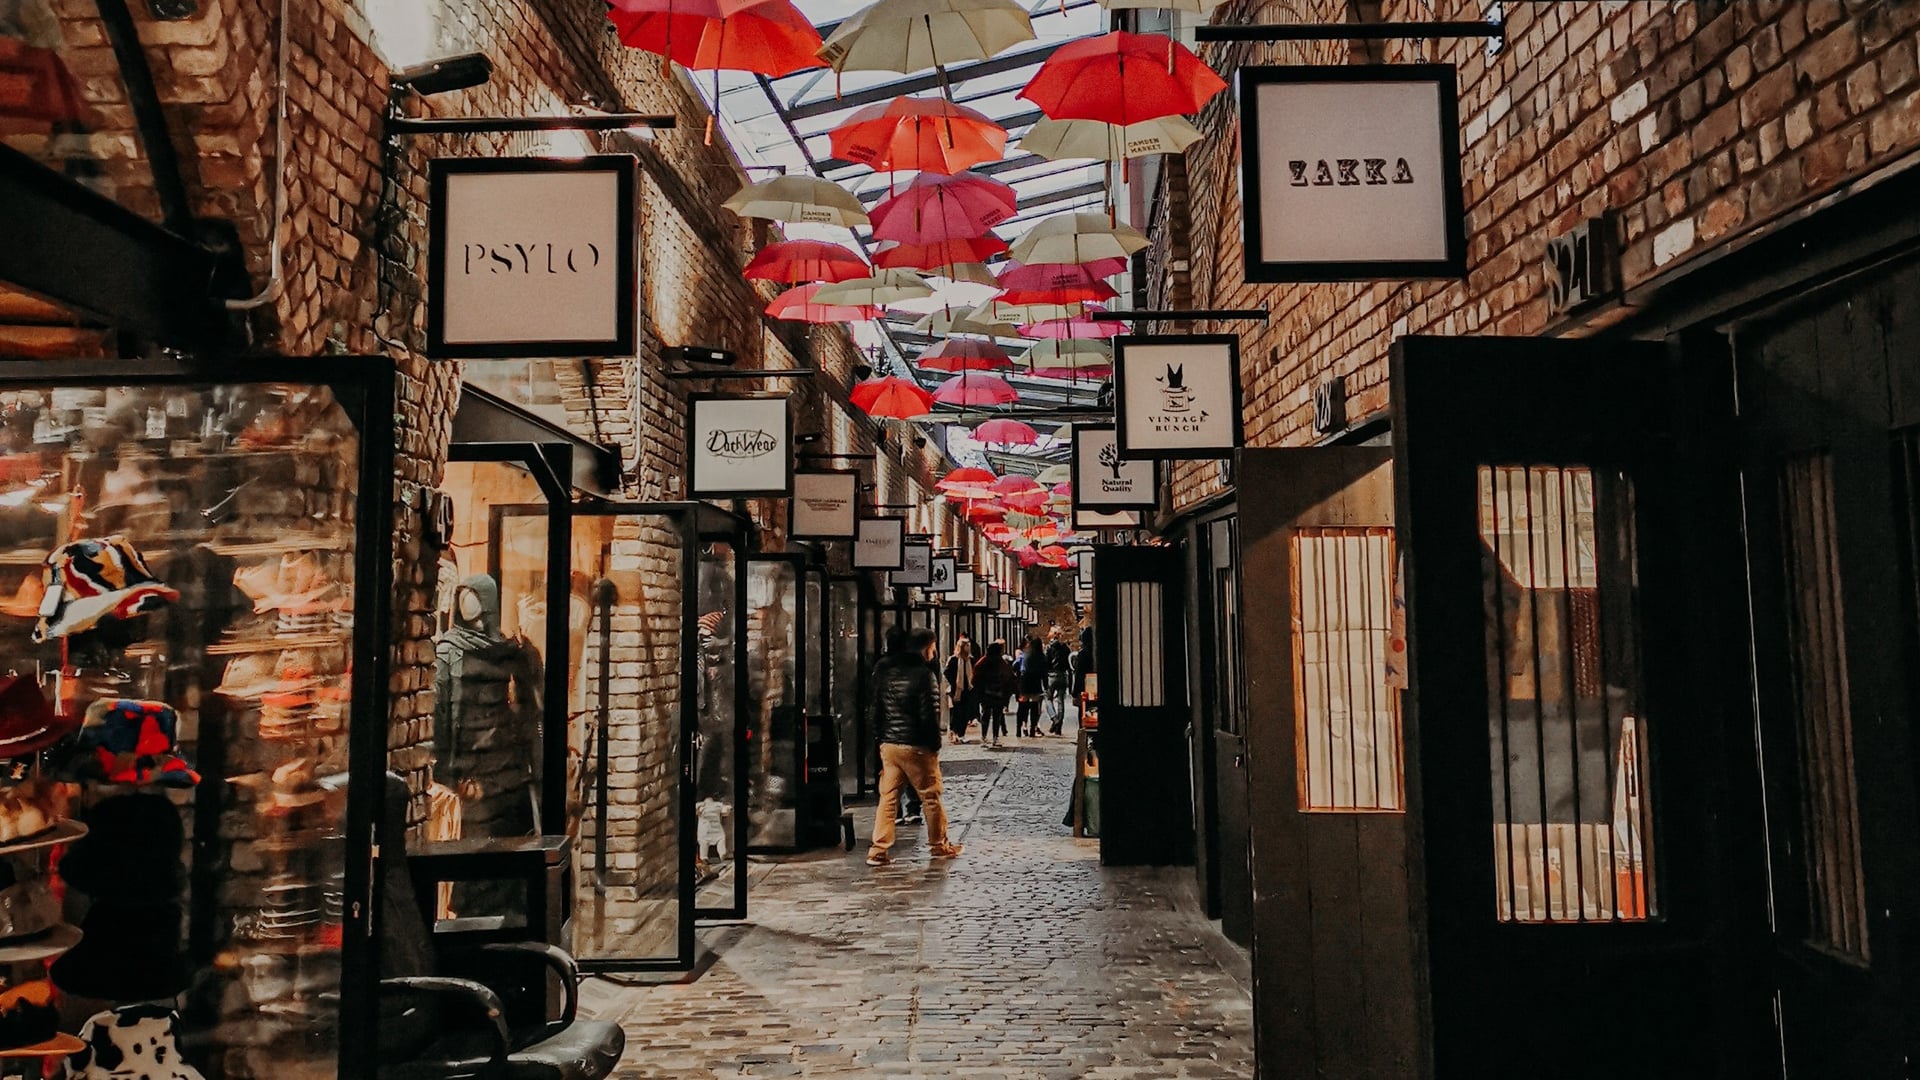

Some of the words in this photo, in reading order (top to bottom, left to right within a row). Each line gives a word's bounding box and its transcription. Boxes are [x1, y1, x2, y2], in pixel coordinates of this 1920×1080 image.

[1128, 137, 1160, 147] CAMDEN
[1130, 144, 1161, 153] MARKET
[1288, 157, 1414, 187] ZAKKA
[464, 242, 600, 275] PSYLO
[1148, 415, 1207, 423] VINTAGE
[1155, 424, 1199, 432] BUNCH
[1101, 478, 1133, 486] Natural
[1102, 485, 1133, 493] Quality
